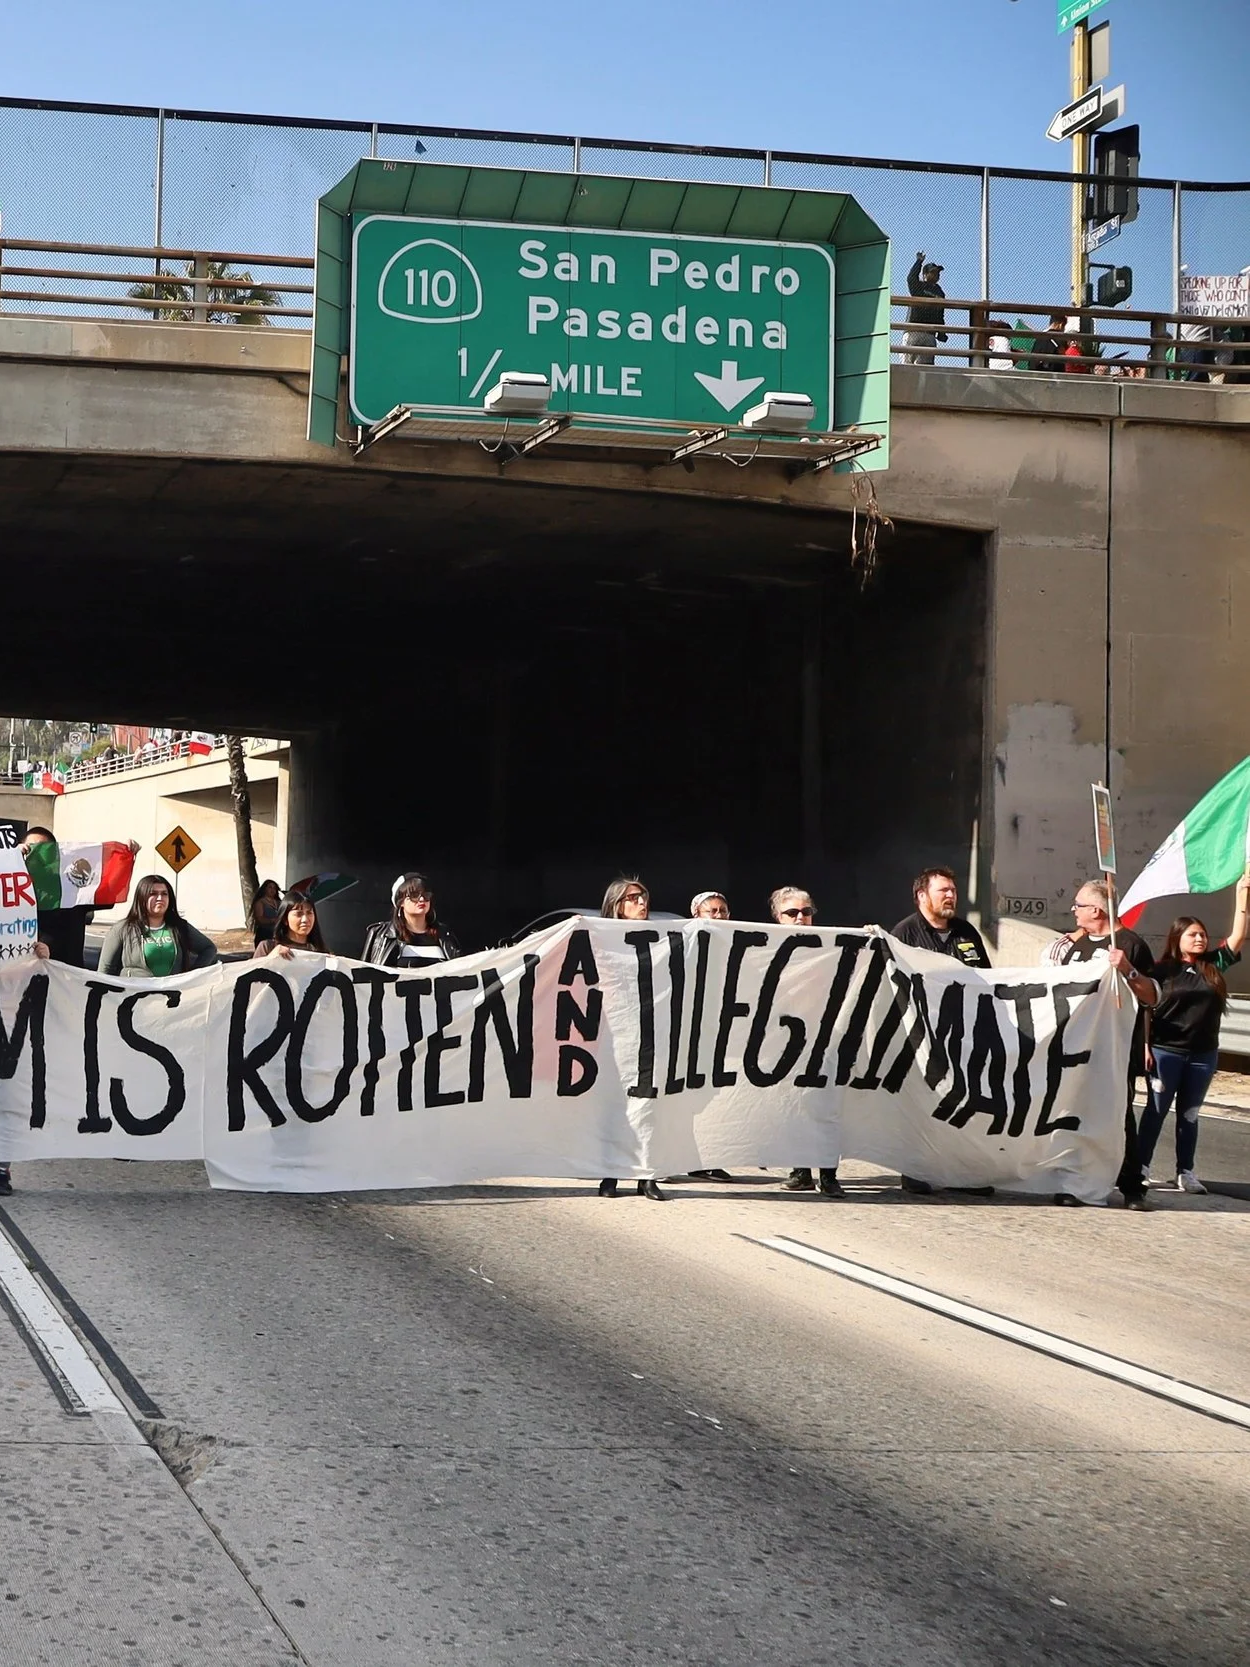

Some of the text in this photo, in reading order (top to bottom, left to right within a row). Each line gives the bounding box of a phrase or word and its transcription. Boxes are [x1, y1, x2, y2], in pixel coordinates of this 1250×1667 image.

[1061, 99, 1096, 129] ONE WAY
[517, 239, 800, 296] San Pedro
[1214, 277, 1227, 289] UP
[1228, 276, 1243, 289] FOR
[404, 268, 457, 308] 110
[1204, 289, 1224, 302] WHO
[527, 295, 788, 350] Pasadena
[458, 347, 642, 398] 1/ MILE
[1007, 900, 1045, 915] 1949
[77, 980, 186, 1136] IS
[227, 953, 540, 1132] ROTTEN
[554, 929, 603, 1098] AND
[624, 929, 1101, 1138] ILLEGITIMATE
